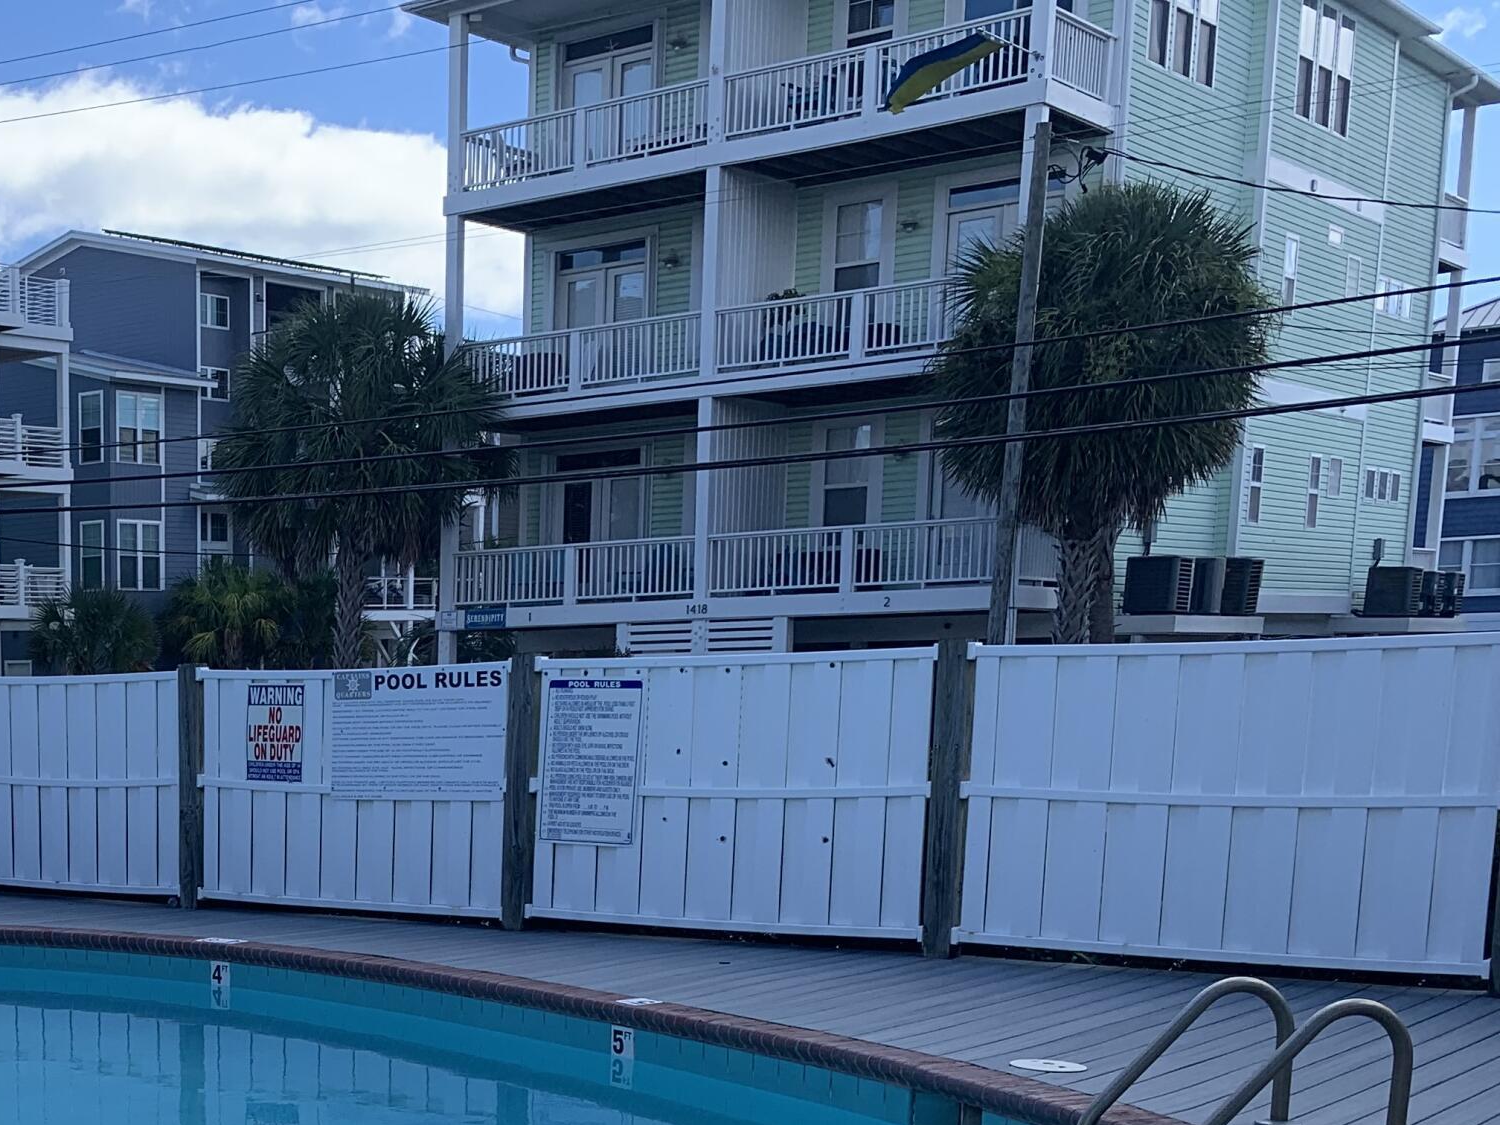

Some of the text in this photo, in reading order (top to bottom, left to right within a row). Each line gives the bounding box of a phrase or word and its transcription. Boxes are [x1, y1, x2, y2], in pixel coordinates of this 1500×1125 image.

[686, 604, 708, 614] 1418
[883, 596, 890, 607] 2
[374, 670, 502, 691] POOL RULES
[250, 687, 303, 705] WARNING
[269, 706, 282, 724] NO
[248, 725, 301, 743] LIFEGUARD
[254, 743, 295, 761] ON DUTY
[212, 965, 222, 984] 4
[613, 1029, 632, 1054] 5 FT
